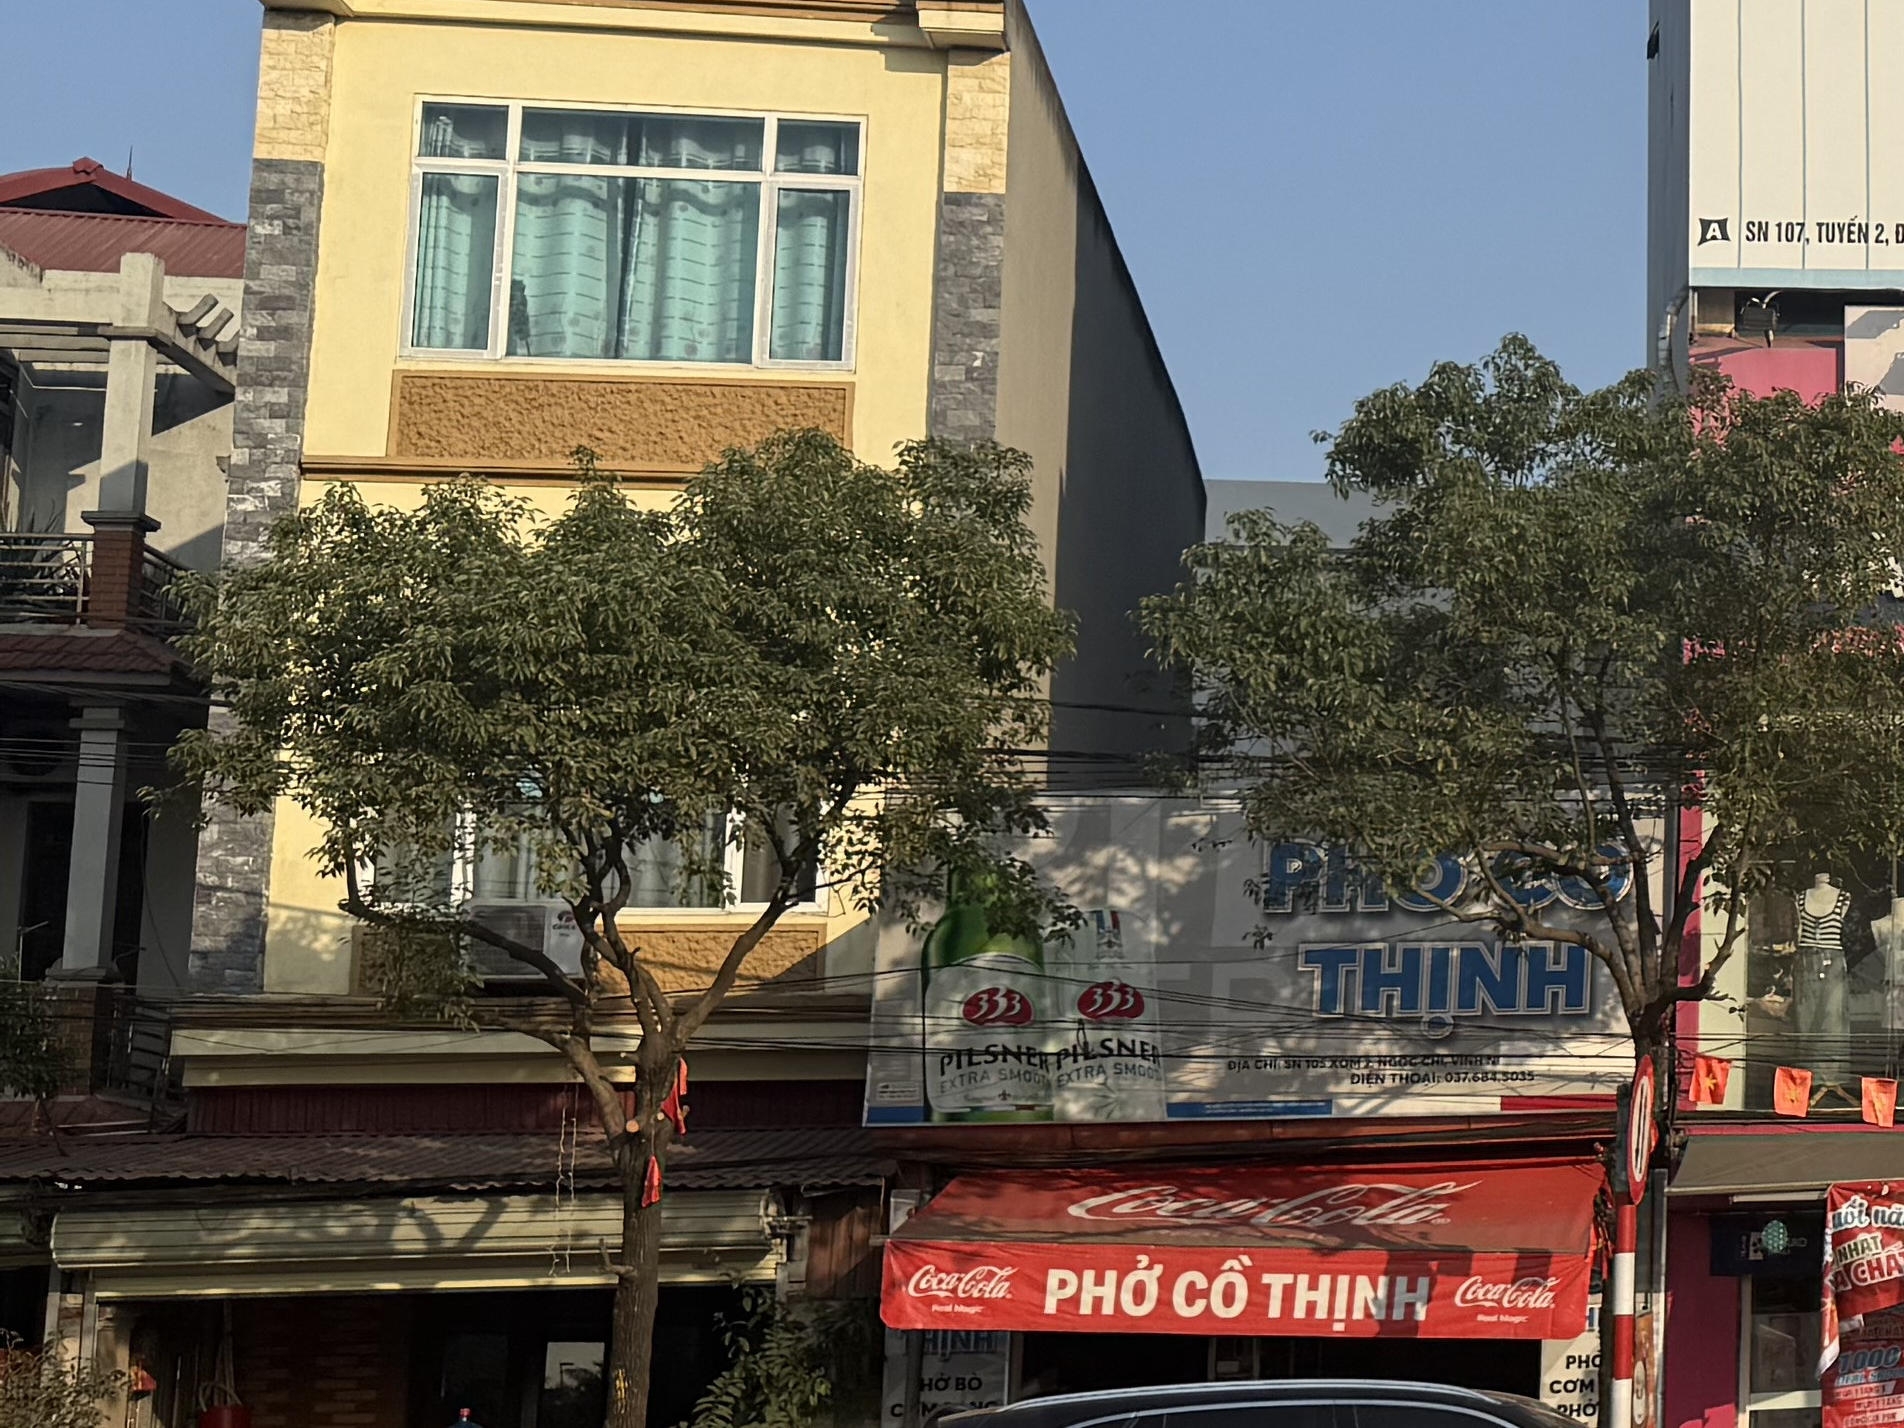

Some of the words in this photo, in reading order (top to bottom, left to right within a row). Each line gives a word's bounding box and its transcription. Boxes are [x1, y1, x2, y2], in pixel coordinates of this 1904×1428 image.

[1745, 222, 1768, 243] SN
[1775, 222, 1810, 245] 107,
[1816, 217, 1869, 244] TUYẾN
[1874, 223, 1890, 246] 2,
[1298, 940, 1592, 1040] THỊNH
[940, 1044, 1052, 1076] PILSNER
[940, 1071, 991, 1094] EXTRA
[1057, 1065, 1107, 1088] EXTRA
[1043, 1254, 1164, 1317] PHỞ
[1172, 1255, 1253, 1318] CỒ
[1261, 1272, 1430, 1332] THỊNH
[955, 1373, 983, 1391] BÒ
[1549, 1378, 1595, 1394] CƠM
